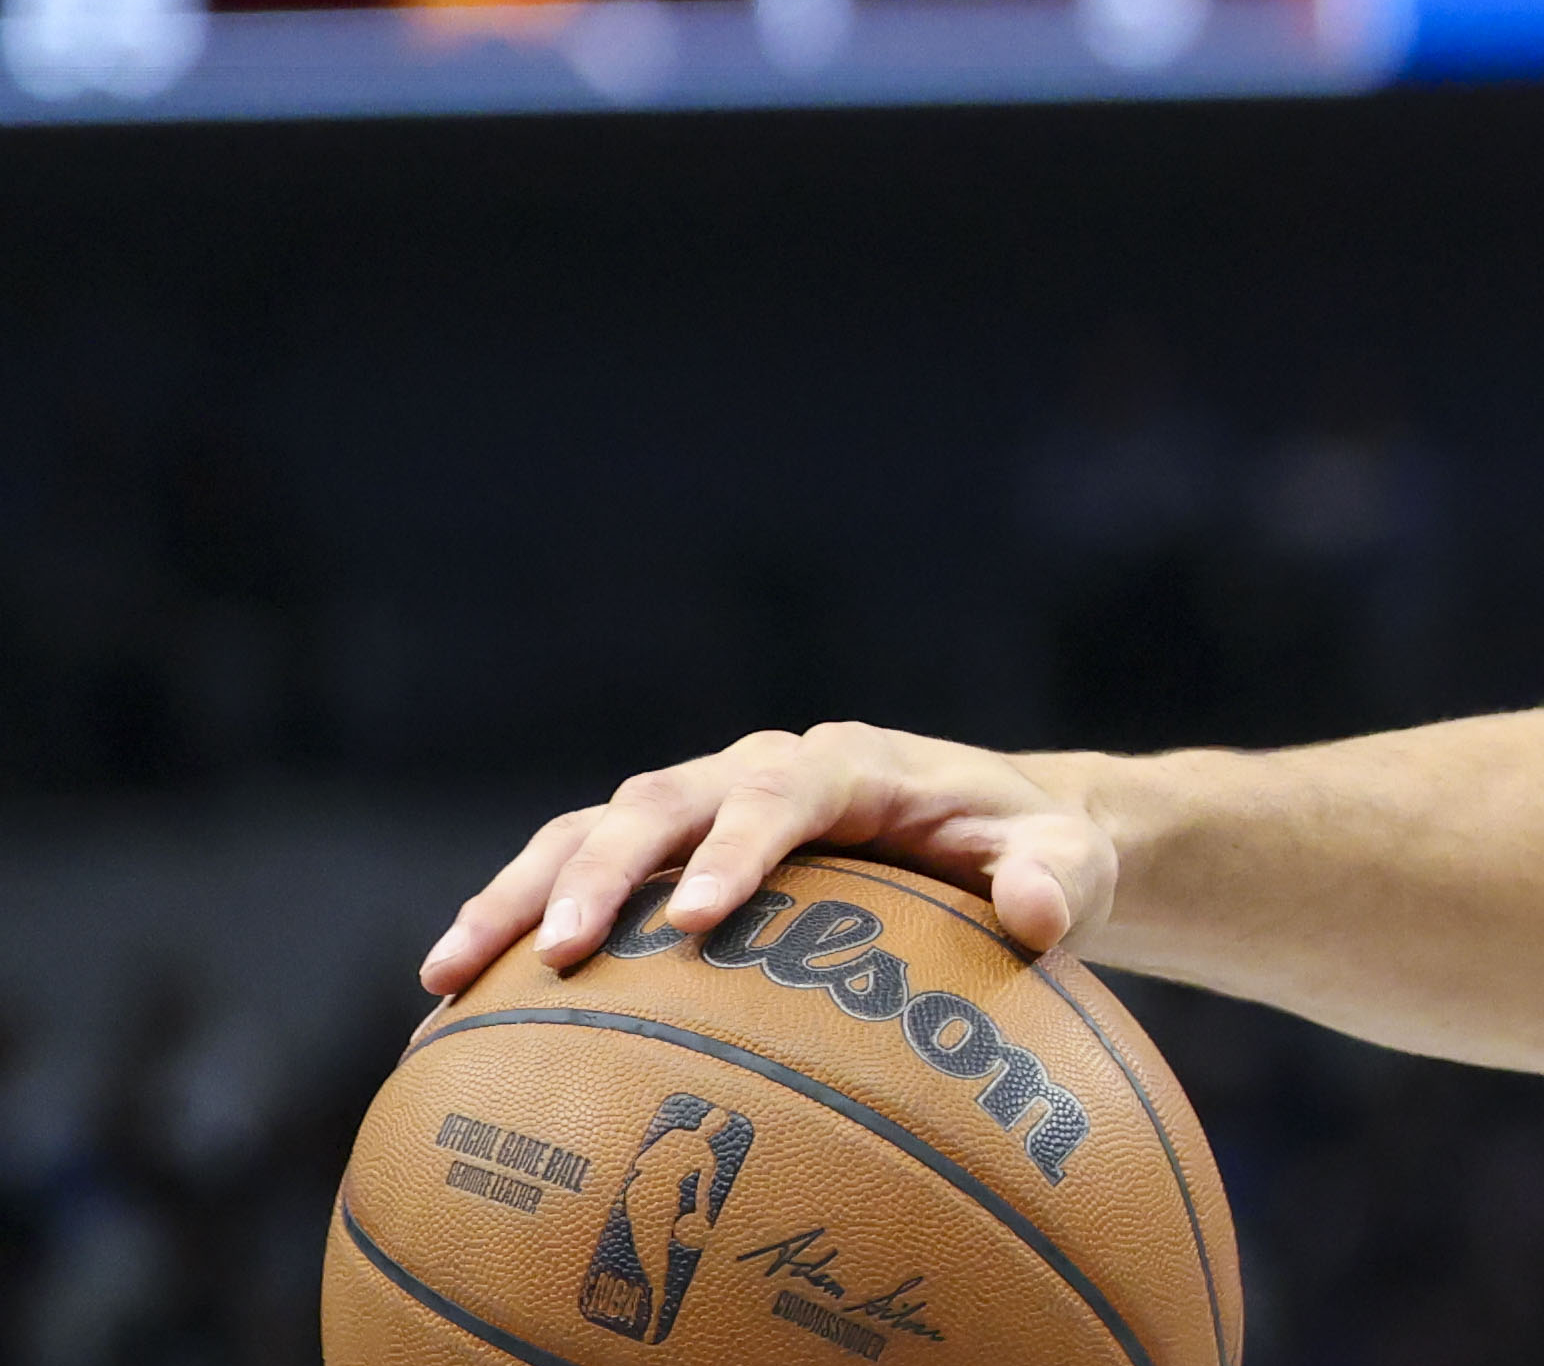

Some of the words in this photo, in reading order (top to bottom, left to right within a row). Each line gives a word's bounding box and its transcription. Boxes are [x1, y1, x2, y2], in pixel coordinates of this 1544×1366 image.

[435, 1112, 502, 1162] OFFICIAL
[495, 1131, 550, 1177] GAME
[541, 1147, 592, 1194] BALL
[771, 1289, 889, 1363] COMMISSIONER
